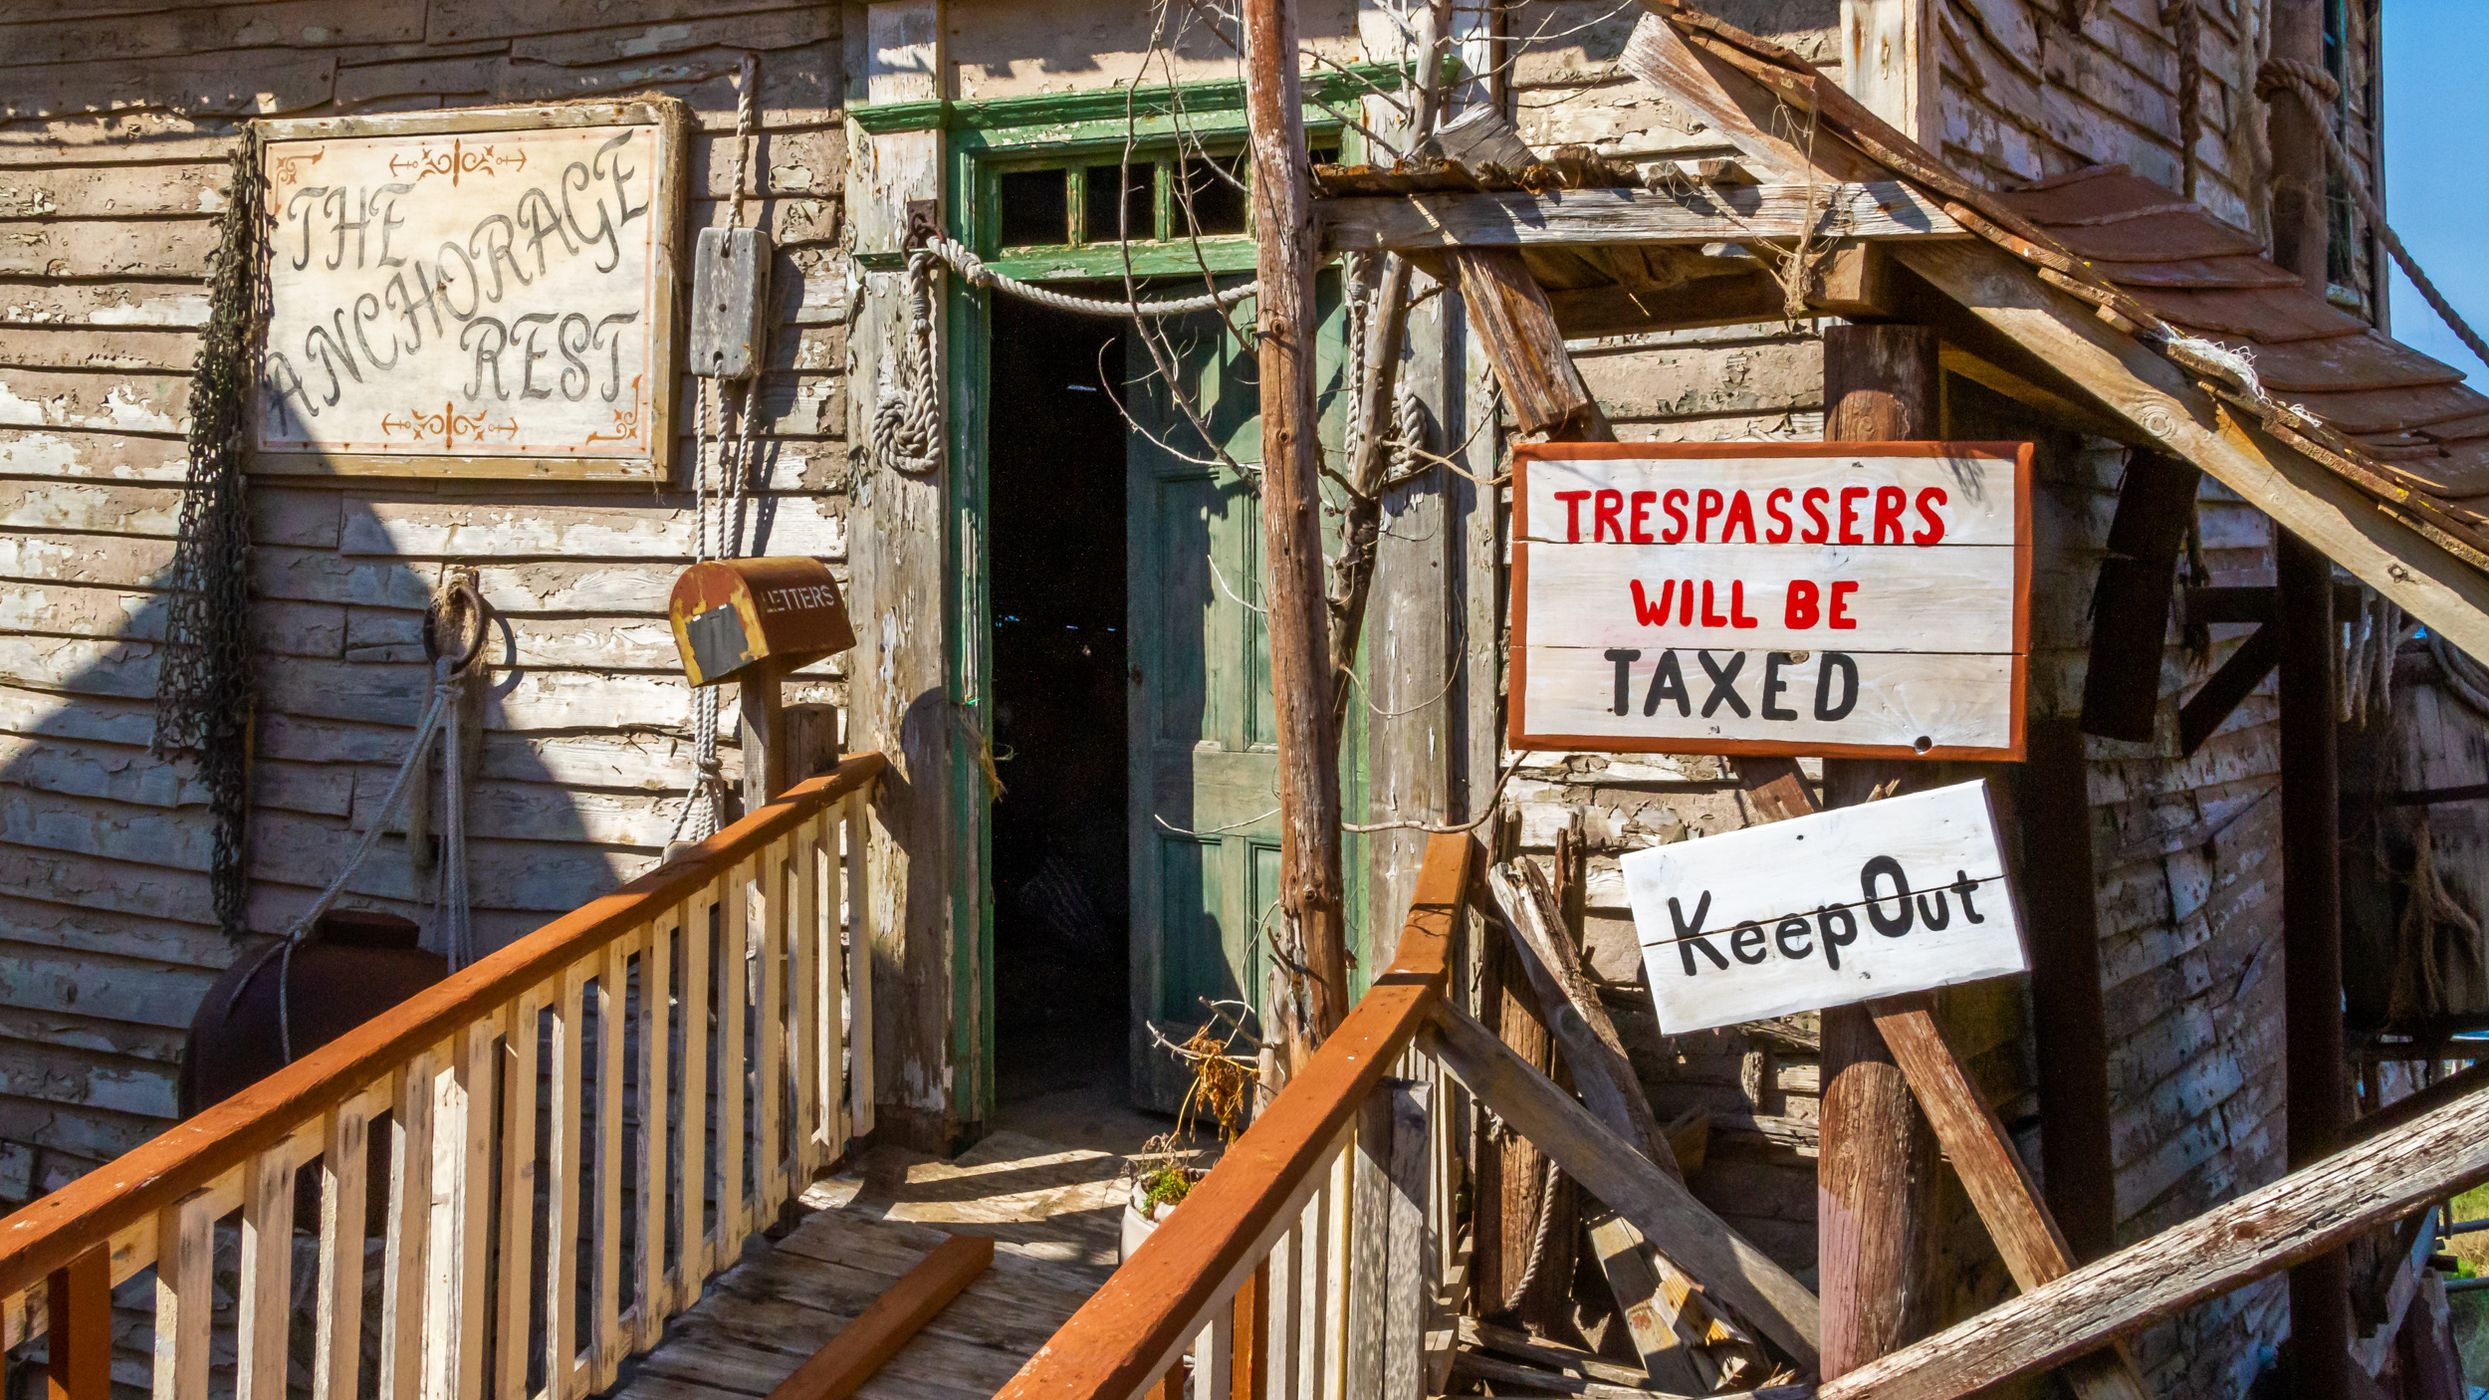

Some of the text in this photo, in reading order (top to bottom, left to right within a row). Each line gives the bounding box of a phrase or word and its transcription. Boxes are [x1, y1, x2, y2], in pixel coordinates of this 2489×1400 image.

[287, 182, 416, 271] THE
[264, 128, 649, 437] ANCHORAGE
[460, 309, 640, 402] REST
[1554, 486, 1948, 547] TRESPASSERS
[1630, 579, 1859, 630] WILL BE
[1604, 648, 1859, 722] TAXED
